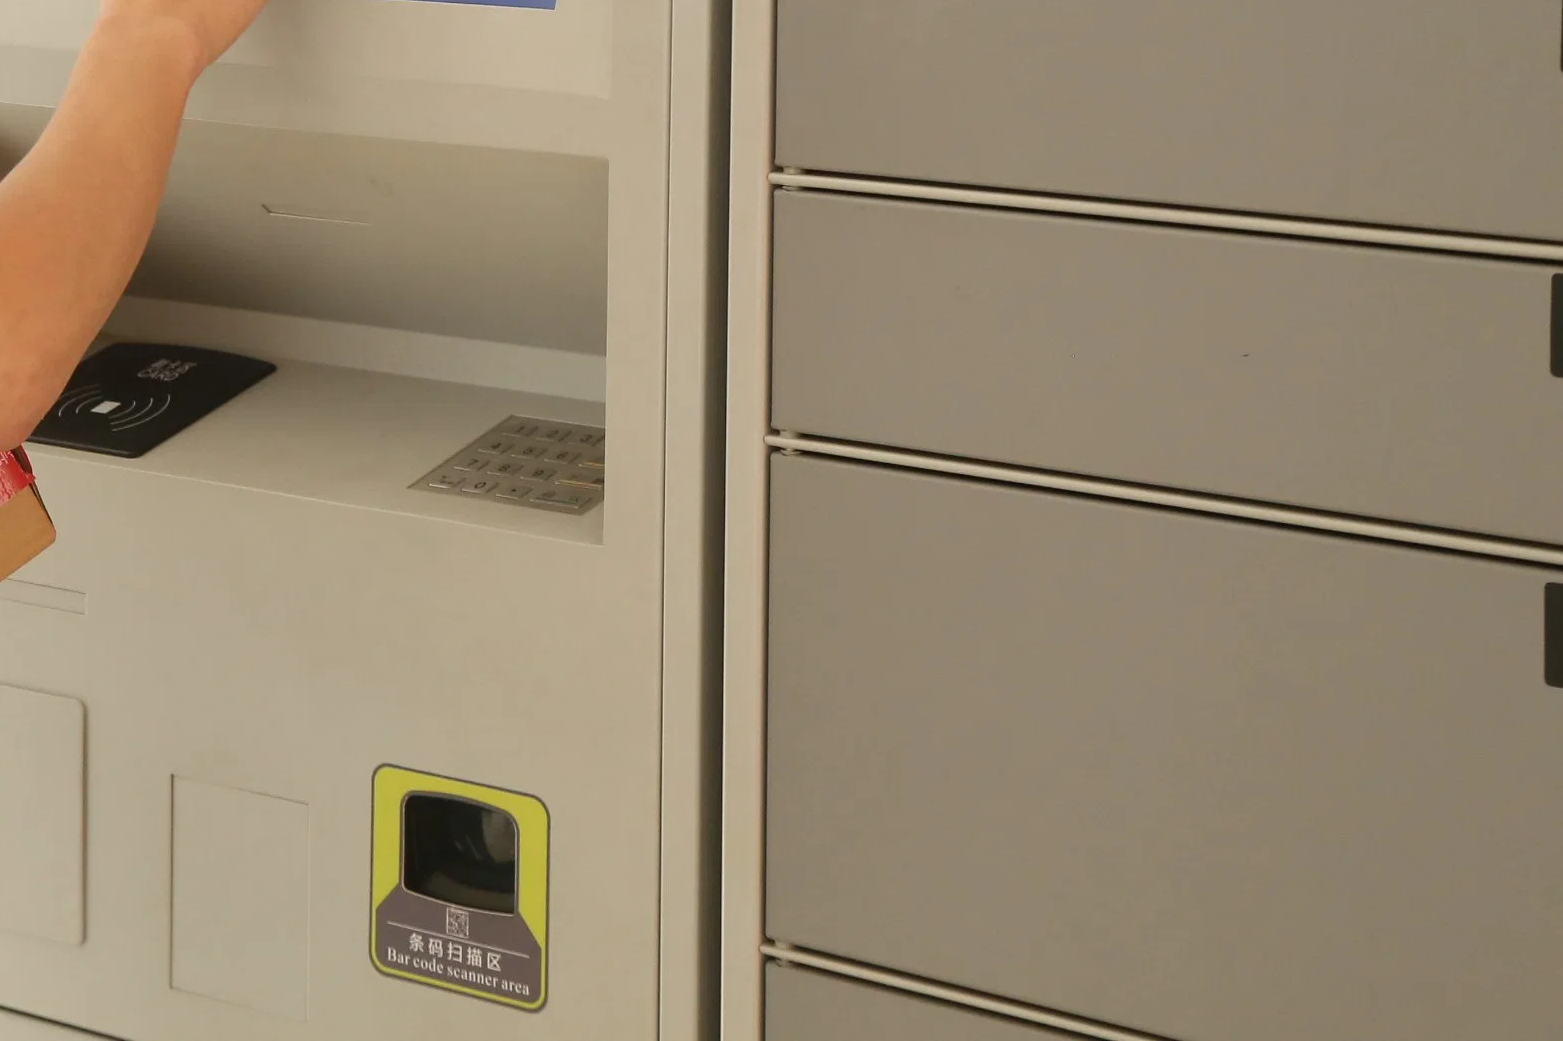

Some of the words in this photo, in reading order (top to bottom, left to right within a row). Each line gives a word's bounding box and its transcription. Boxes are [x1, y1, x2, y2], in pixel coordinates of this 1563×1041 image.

[387, 946, 410, 965] Bar
[413, 956, 444, 974] code
[446, 965, 499, 988] scanner
[501, 979, 530, 996] area
[408, 932, 501, 972] 条码扫描区
